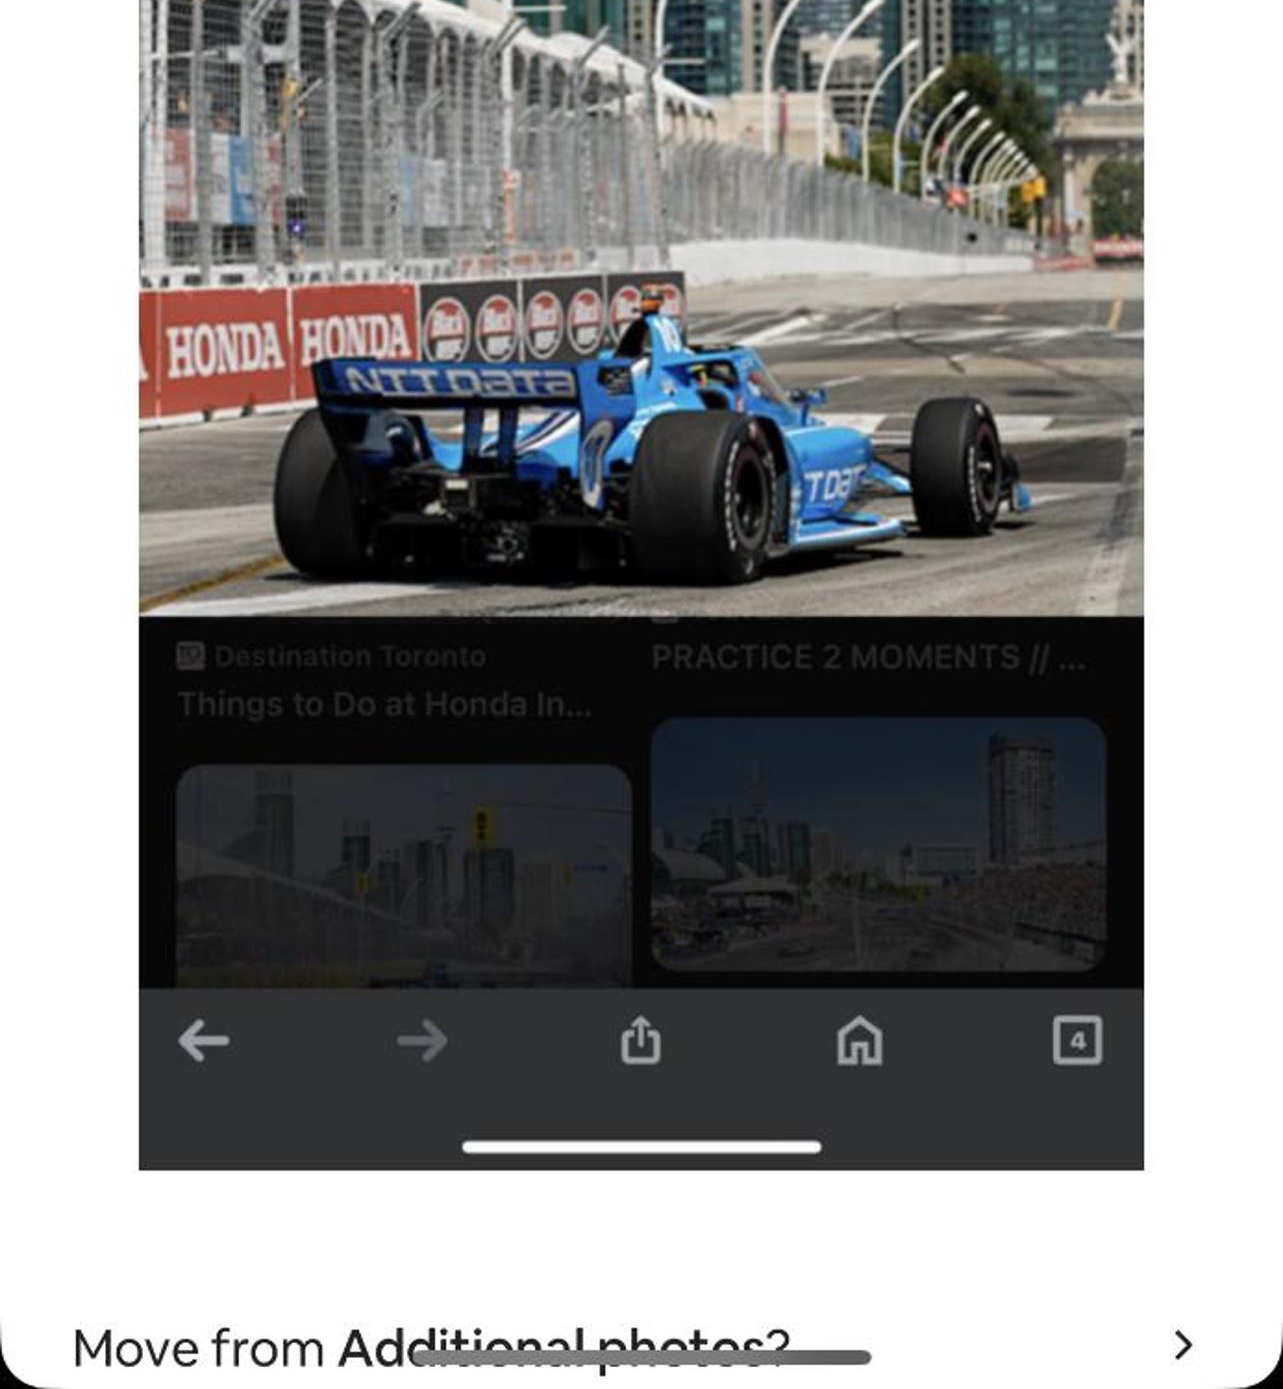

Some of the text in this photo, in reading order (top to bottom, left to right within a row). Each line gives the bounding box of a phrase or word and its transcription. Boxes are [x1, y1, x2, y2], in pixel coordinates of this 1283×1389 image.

[165, 321, 286, 380] HONDA
[299, 313, 412, 368] HONDA
[215, 643, 372, 669] Destination
[379, 643, 488, 669] Toronto
[652, 643, 811, 671] PRACTICE
[823, 643, 841, 670] 2
[851, 643, 1021, 671] MOMENTS
[177, 690, 284, 722] Things
[293, 691, 324, 718] to
[333, 690, 377, 718] Do
[386, 691, 415, 718] at
[425, 690, 528, 718] Honda
[1069, 1031, 1087, 1050] 4
[75, 1327, 199, 1368] Move
[210, 1327, 324, 1368] from
